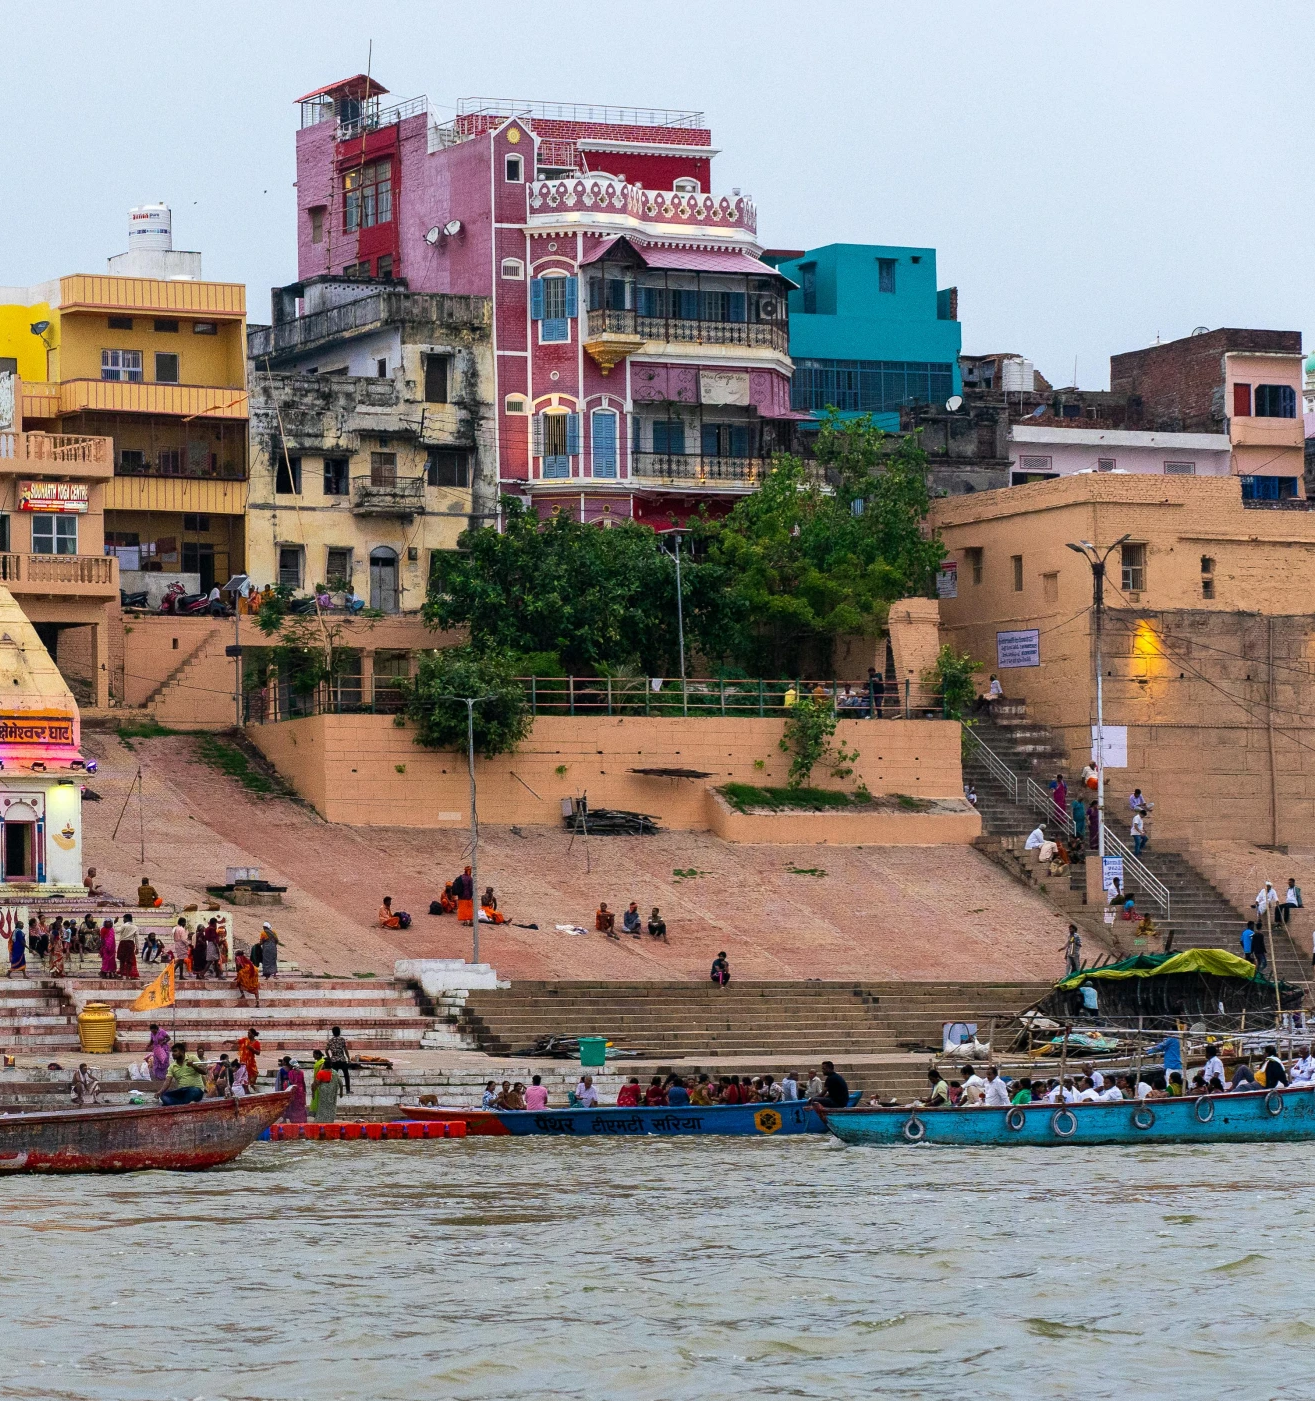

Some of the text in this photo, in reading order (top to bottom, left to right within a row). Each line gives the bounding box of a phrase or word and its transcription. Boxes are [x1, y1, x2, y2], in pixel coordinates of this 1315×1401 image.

[48, 726, 69, 740] घाट
[592, 1116, 644, 1133] टीएमटी
[651, 1115, 704, 1131] सरिया
[795, 1109, 802, 1123] 1
